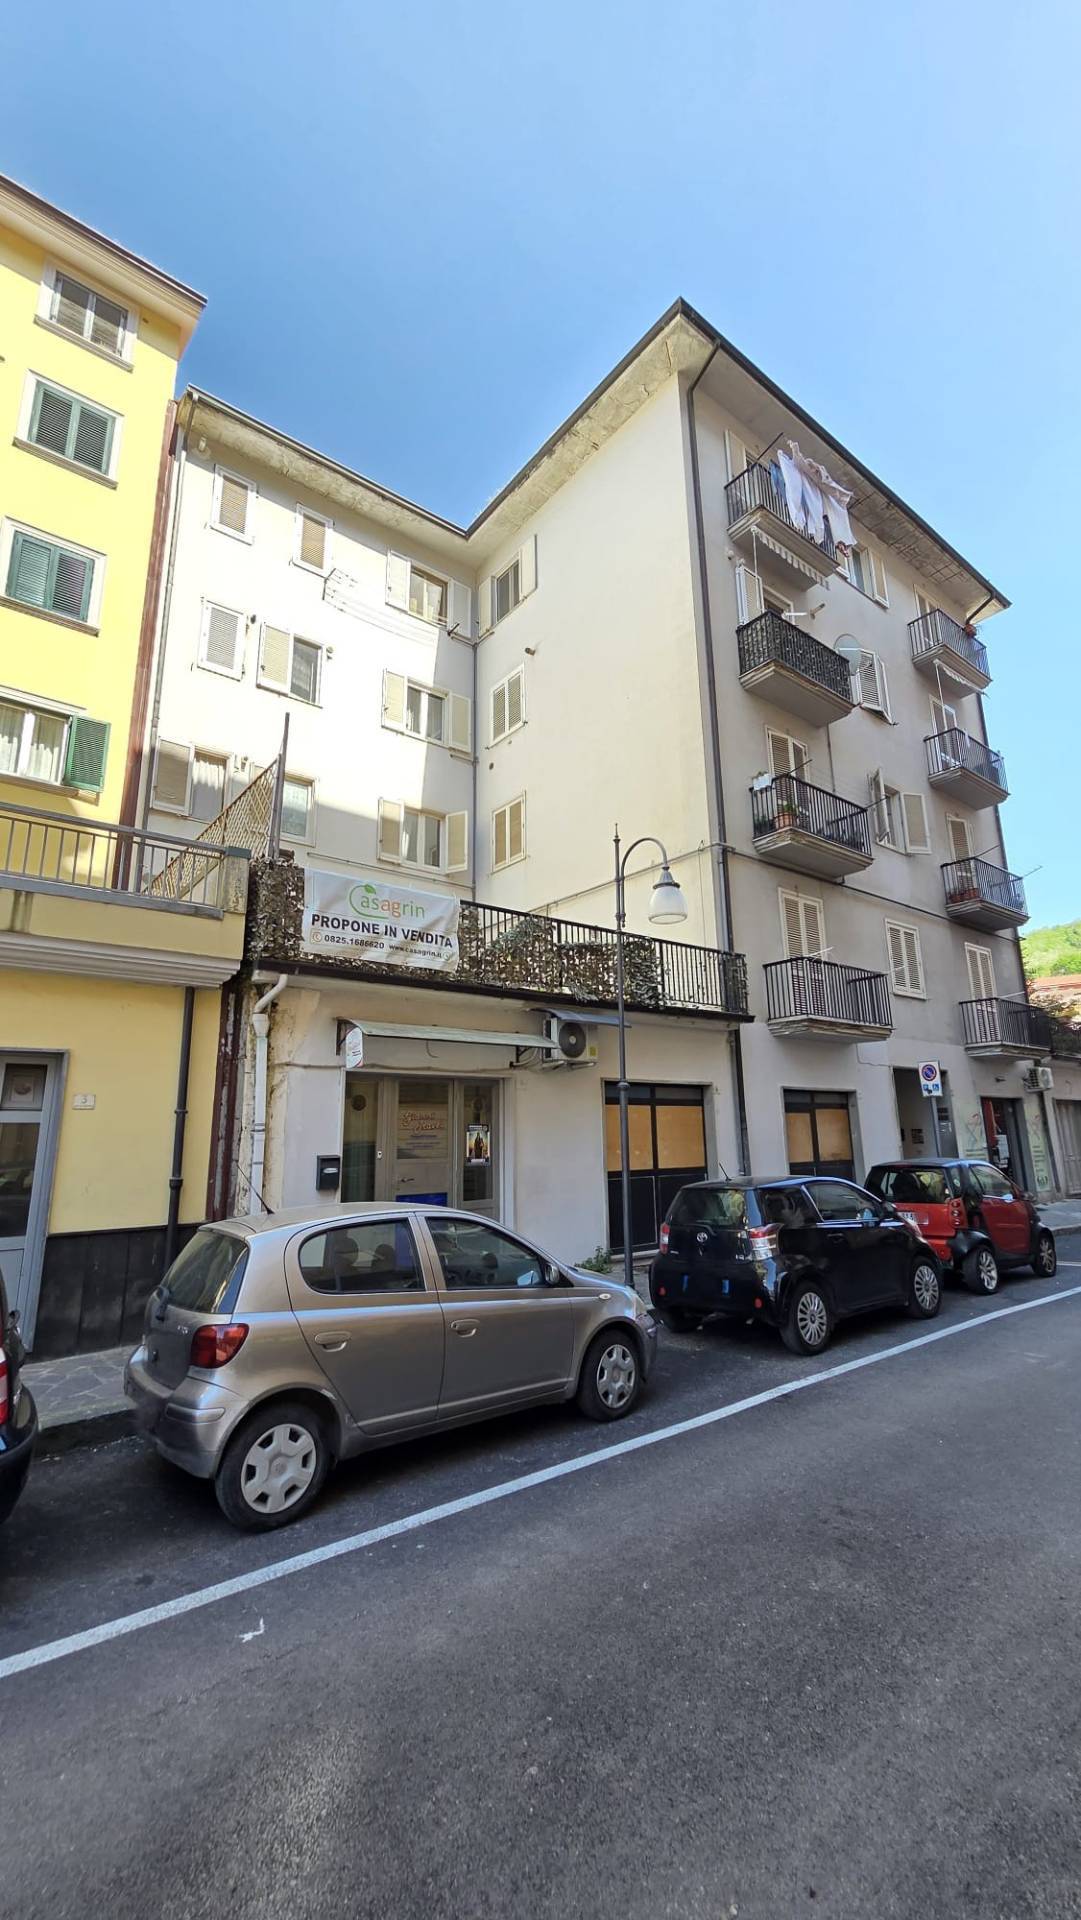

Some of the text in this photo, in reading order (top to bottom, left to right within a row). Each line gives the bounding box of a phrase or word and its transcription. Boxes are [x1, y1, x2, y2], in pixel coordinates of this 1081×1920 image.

[349, 884, 425, 919] Casagrin
[312, 914, 453, 948] PROPONE IN VENDITA
